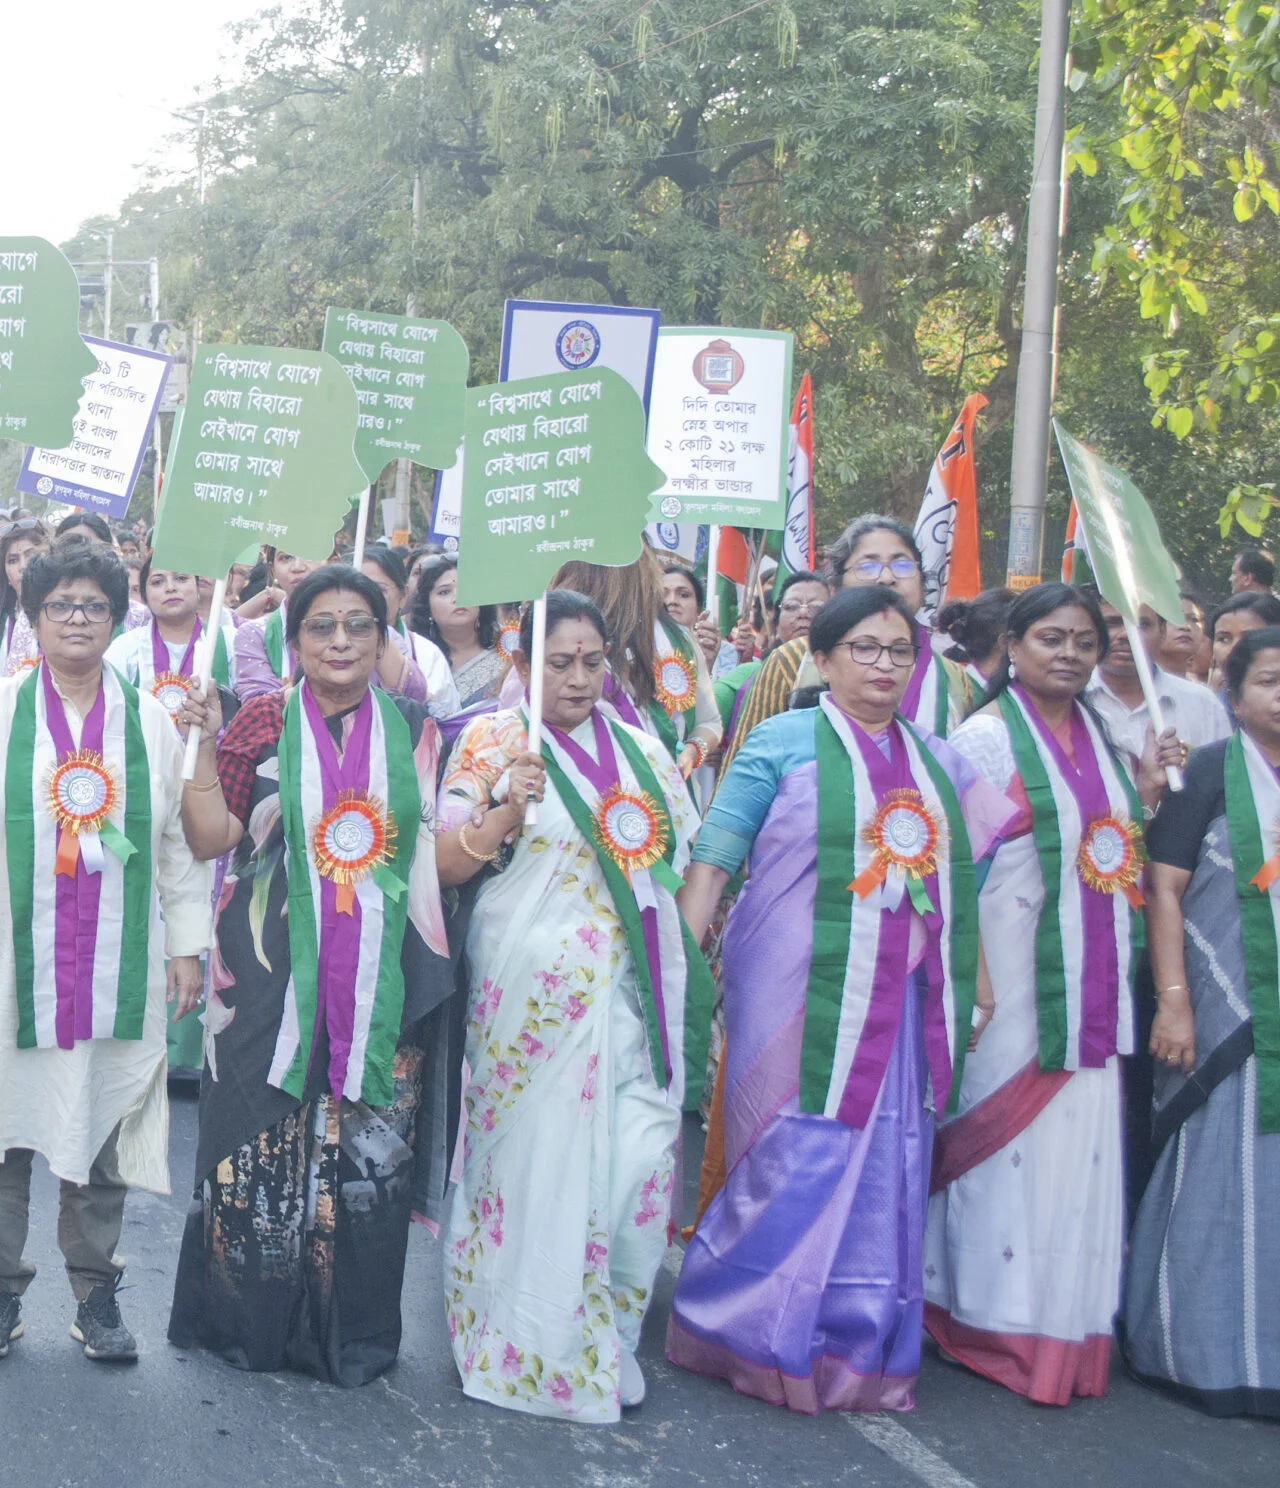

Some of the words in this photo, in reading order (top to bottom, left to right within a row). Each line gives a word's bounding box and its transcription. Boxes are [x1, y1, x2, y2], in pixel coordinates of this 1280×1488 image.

[403, 326, 439, 342] যোগে
[339, 341, 375, 358] যেথায়
[380, 342, 425, 364] বিহারো
[277, 364, 322, 386] যোগে
[396, 372, 425, 388] যোগ
[99, 381, 148, 403] পরিচালিত
[204, 389, 243, 409] যেথায়
[247, 386, 303, 416] বিহারো
[357, 390, 379, 406] মার
[383, 394, 414, 410] সাথে
[560, 380, 602, 405] যোগে
[88, 401, 113, 419] থানা
[682, 396, 708, 411] দিদি
[715, 401, 757, 414] তোমার
[5, 413, 27, 430] ঠাকুর
[92, 424, 118, 441] বাংলা
[200, 416, 258, 443] সেইখানে
[264, 427, 301, 448] যোগ
[483, 424, 527, 446] যেথায়
[532, 413, 589, 439] বিহারো
[682, 420, 707, 432] স্নেহ
[712, 420, 748, 433] অপার
[70, 437, 112, 459] হিলাদের
[665, 440, 672, 451] ২
[679, 435, 712, 451] কোটি
[719, 441, 735, 453] ২১
[741, 441, 765, 454] লক্ষ
[195, 451, 241, 472] তোমার
[247, 456, 284, 478] সাথে
[485, 451, 550, 476] সেইখানে
[556, 444, 592, 467] যোগ
[690, 456, 736, 472] মহিলার
[485, 484, 536, 507] তোমার
[543, 476, 581, 498] সাথে
